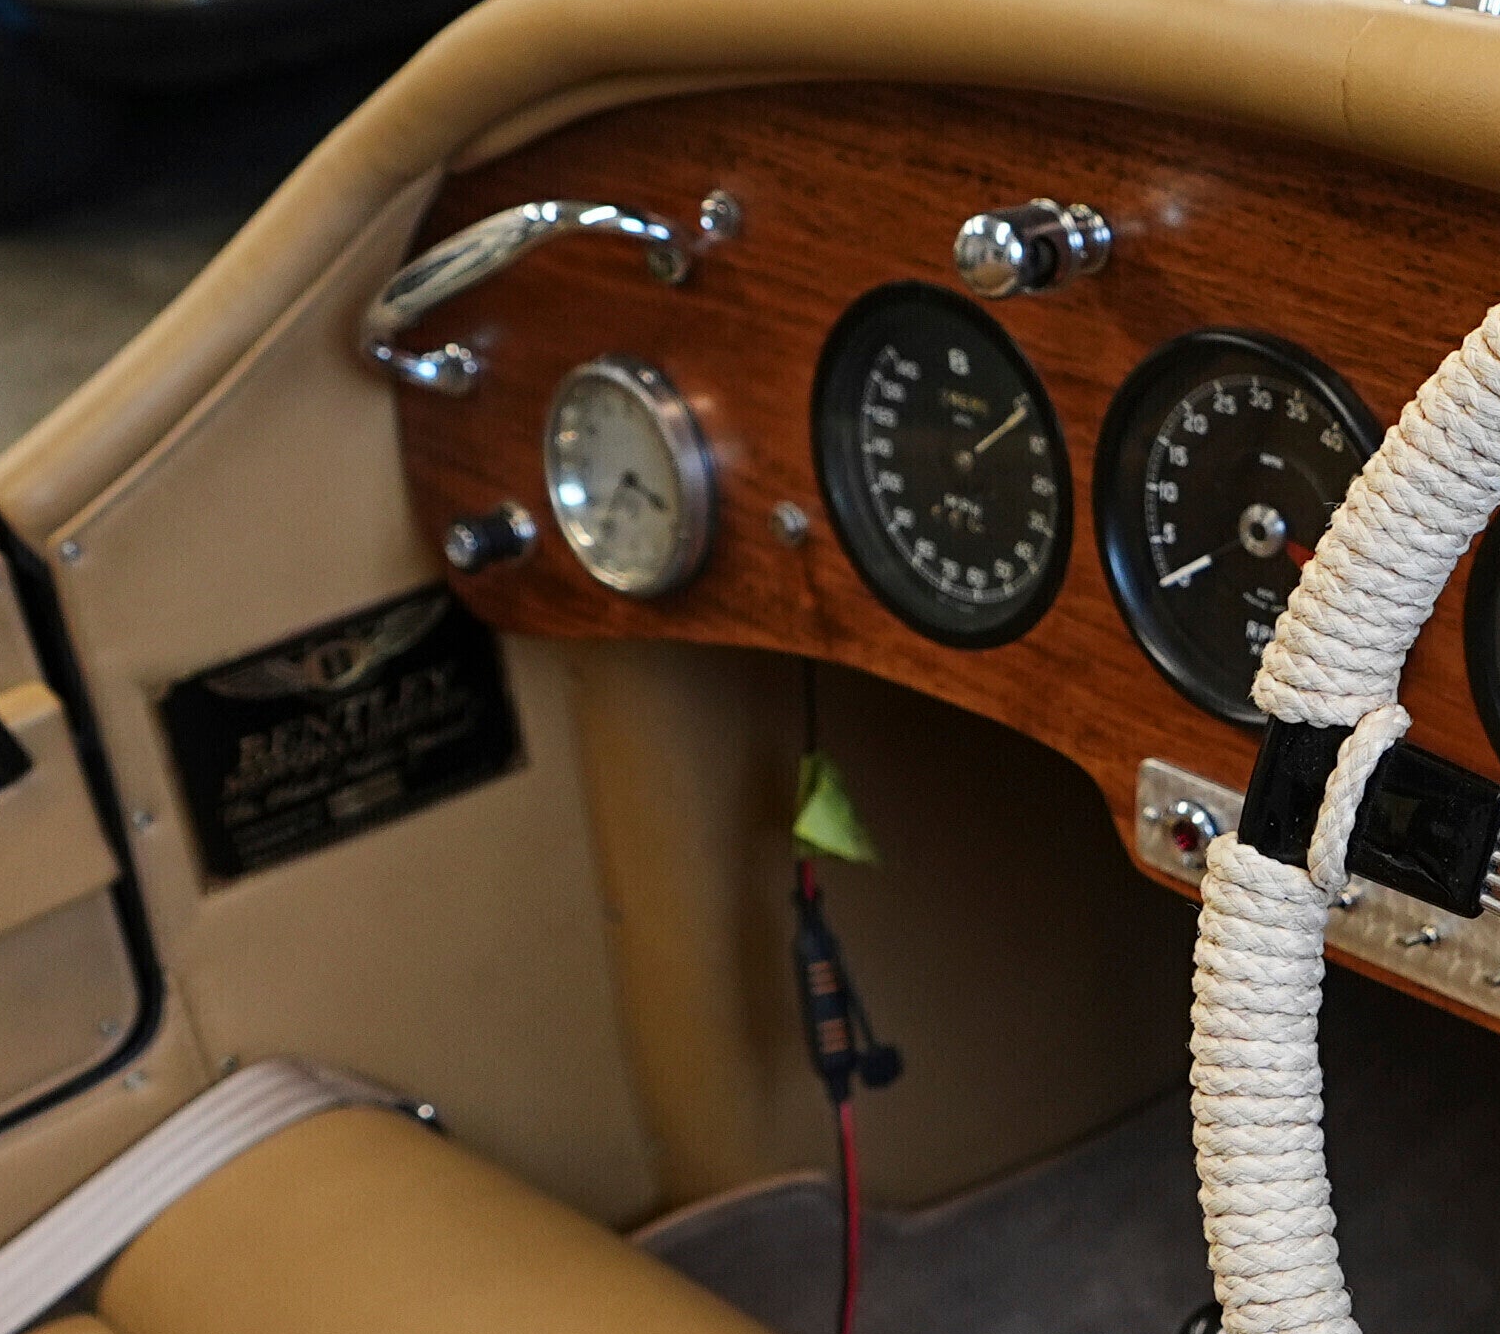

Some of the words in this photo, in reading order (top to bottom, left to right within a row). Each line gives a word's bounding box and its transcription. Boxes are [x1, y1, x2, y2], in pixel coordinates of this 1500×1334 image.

[1213, 392, 1238, 416] 25
[1250, 389, 1274, 411] 30
[1286, 397, 1309, 424] 35
[1183, 413, 1208, 435] 20
[1169, 444, 1189, 468] 15
[1159, 480, 1179, 504] 10
[1162, 522, 1177, 545] 5
